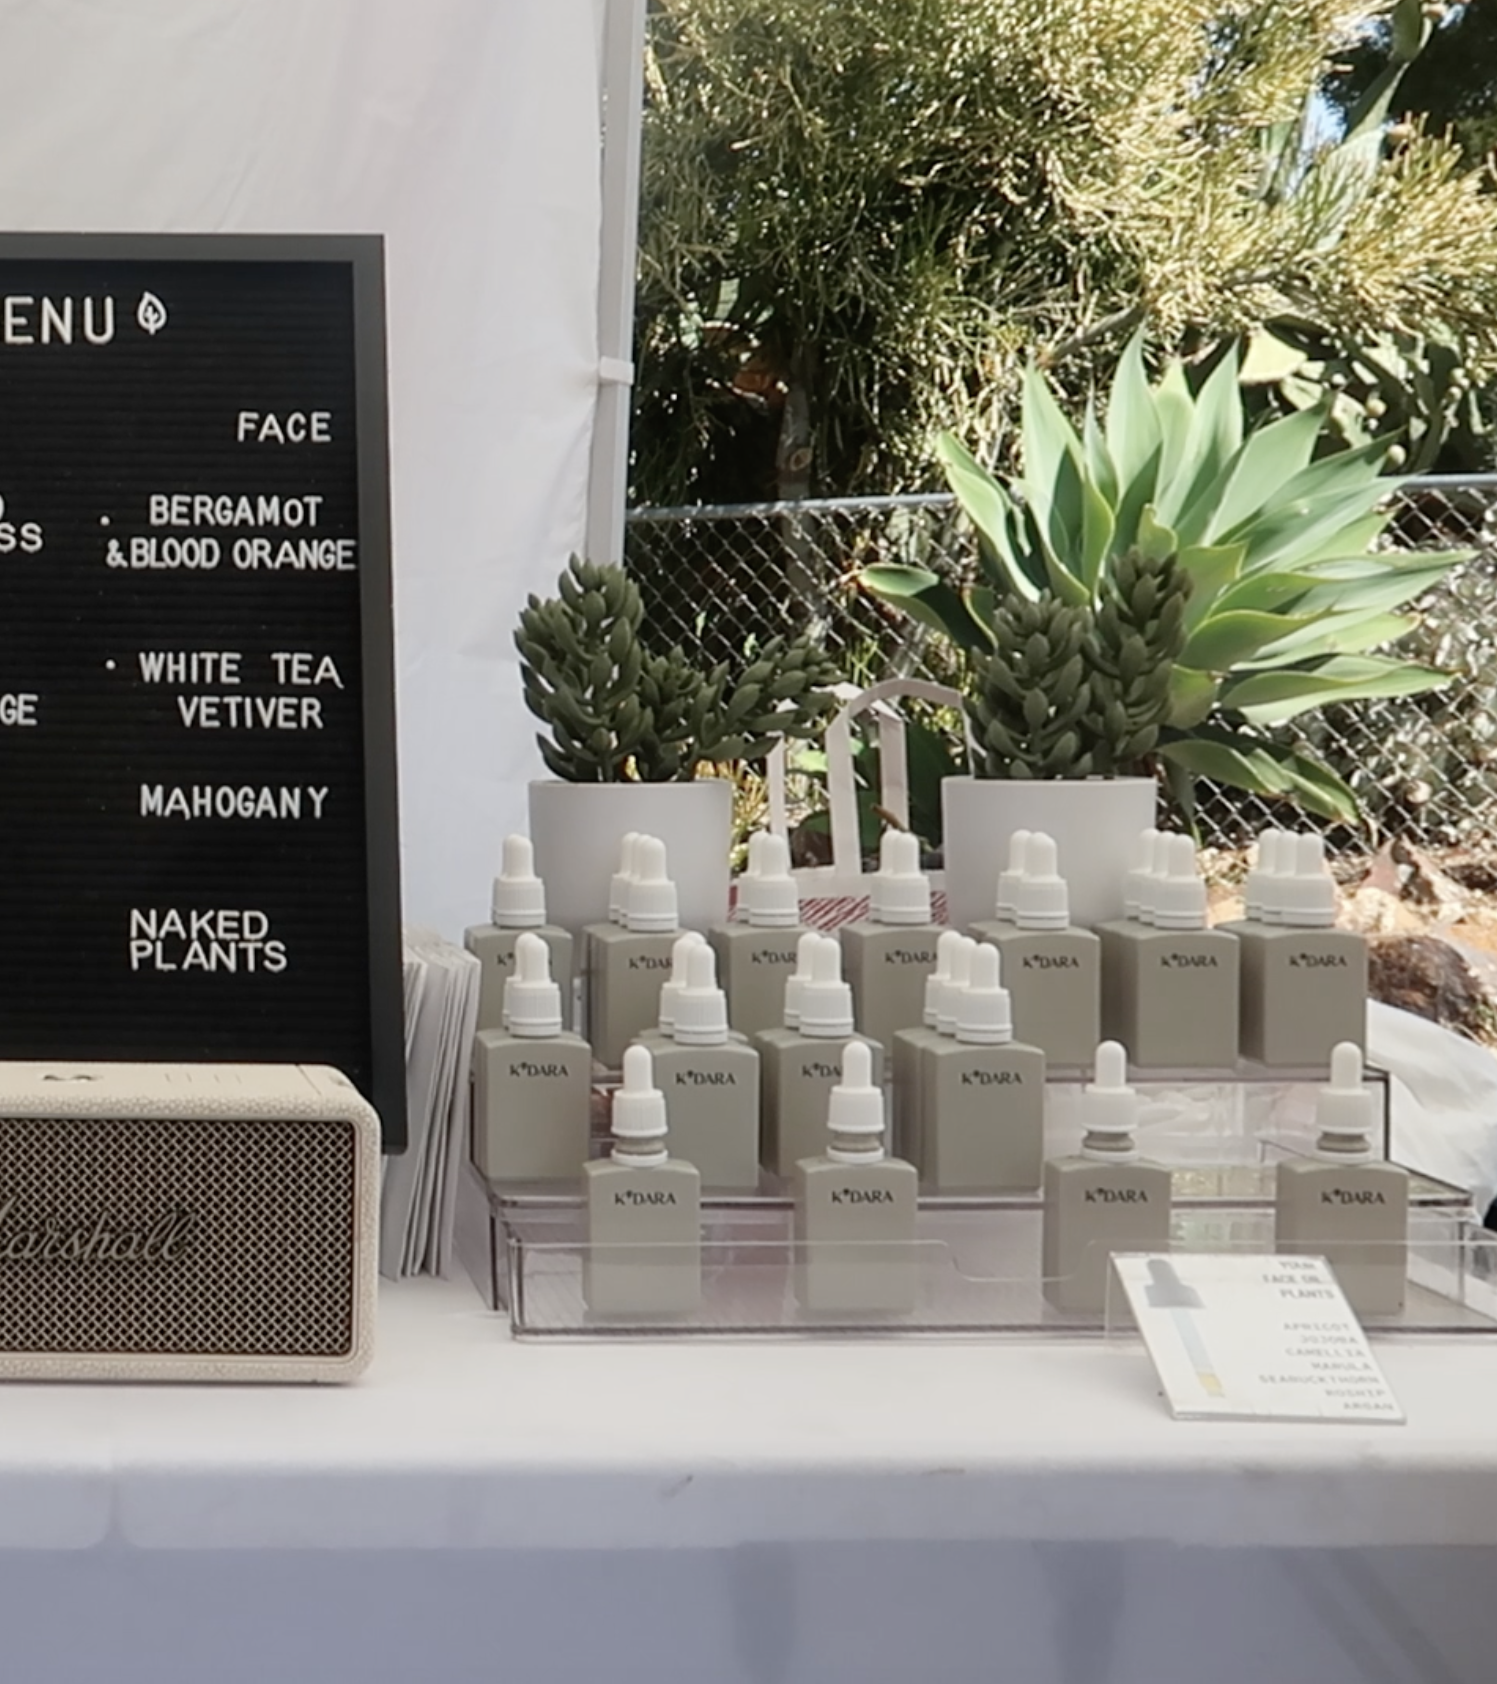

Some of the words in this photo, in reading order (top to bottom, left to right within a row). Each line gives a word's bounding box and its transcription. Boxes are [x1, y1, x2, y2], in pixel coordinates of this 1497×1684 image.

[237, 411, 331, 444] FACE
[149, 494, 323, 528] BERGAMOT
[232, 538, 356, 570] ORANGE
[138, 651, 242, 684] WHITE
[270, 652, 344, 689] TEA
[177, 695, 324, 729] VETIVER
[140, 783, 329, 821] MAHOGANY
[129, 908, 269, 941] NAKED
[129, 940, 288, 973] PLANTS
